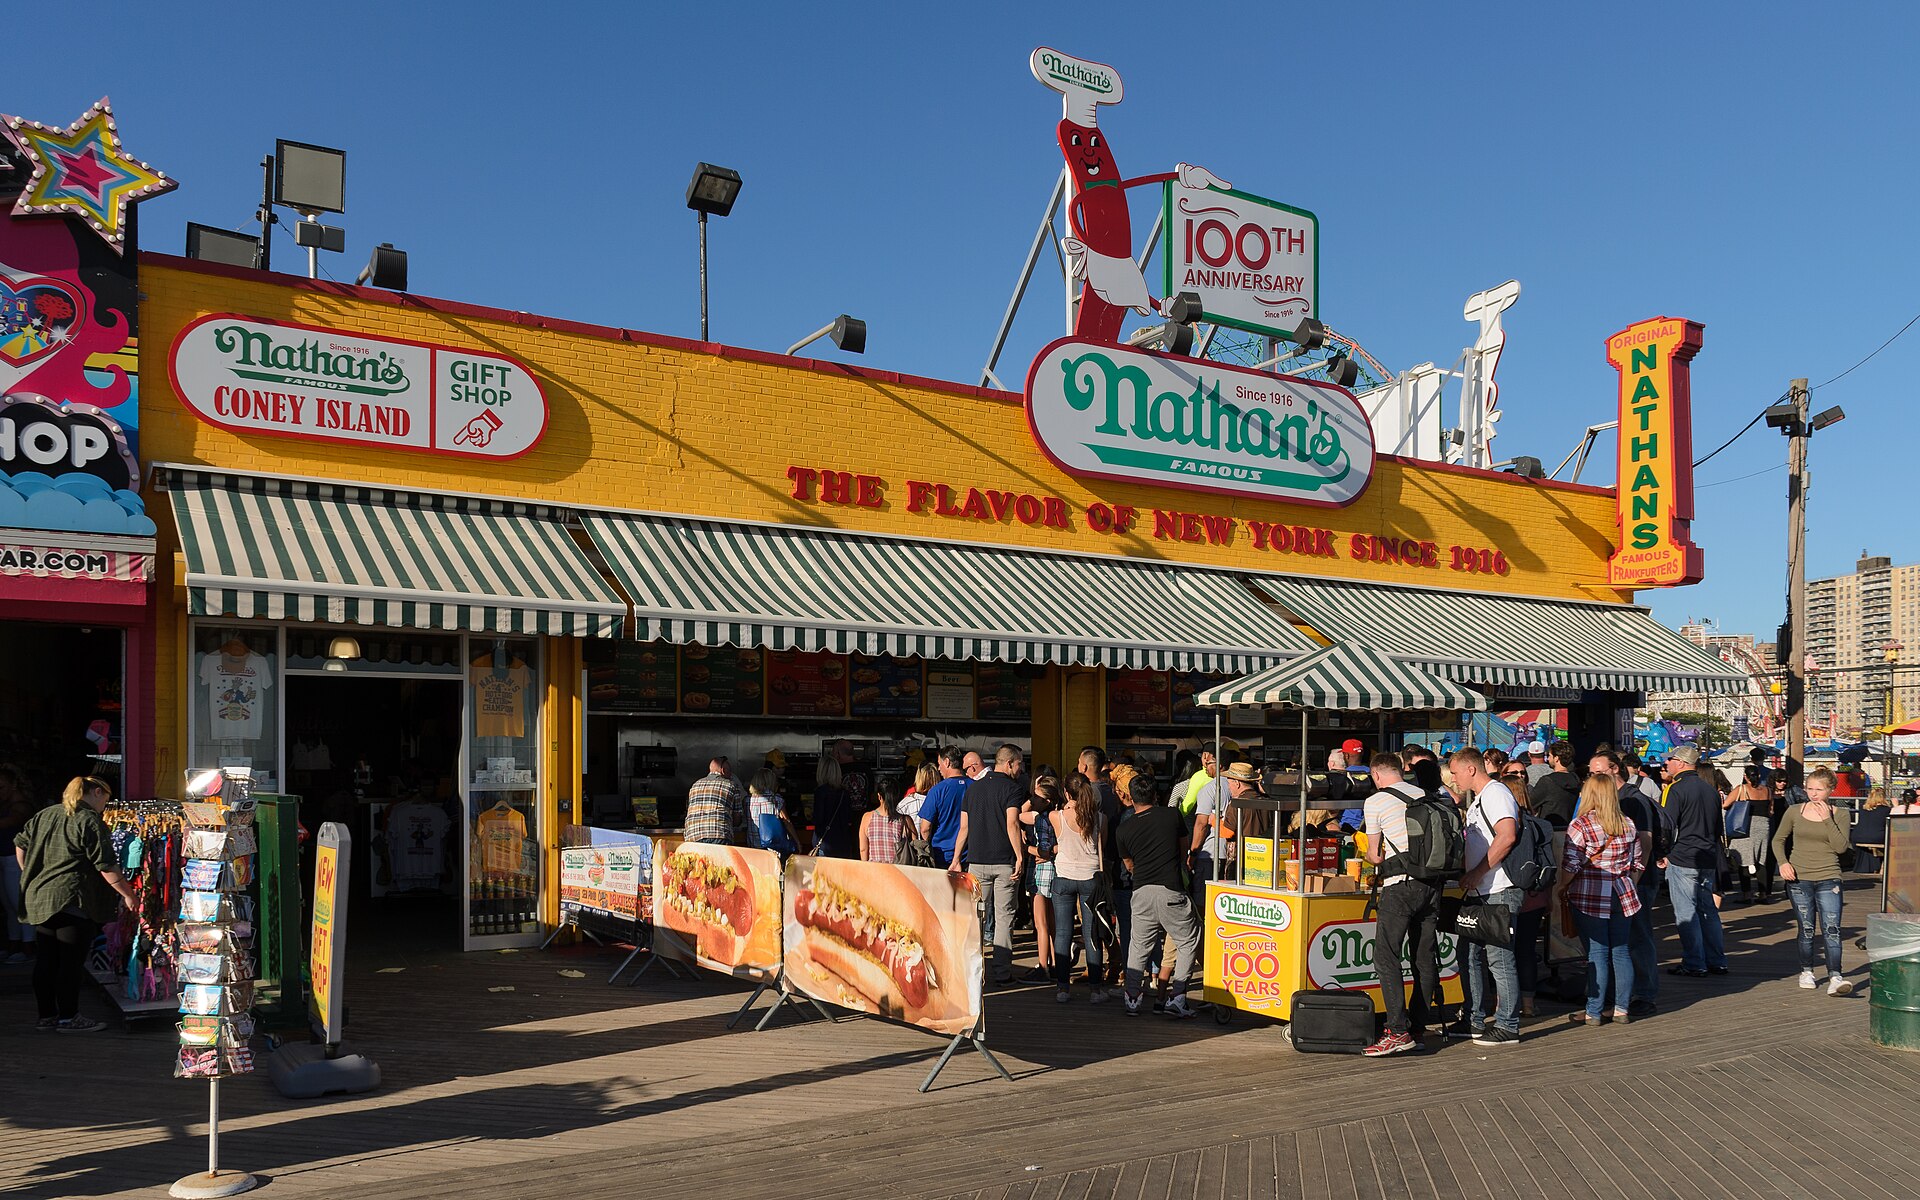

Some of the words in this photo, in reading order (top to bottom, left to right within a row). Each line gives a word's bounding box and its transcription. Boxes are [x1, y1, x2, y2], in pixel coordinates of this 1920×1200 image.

[1042, 54, 1111, 88] Nathan's
[1184, 218, 1305, 270] 100TH
[1184, 268, 1305, 293] ANNIVERSARY
[1264, 310, 1280, 319] Since
[1280, 308, 1294, 318] 1916
[329, 343, 351, 353] Since
[352, 346, 370, 355] 1916
[1613, 324, 1677, 349] ORIGINAL
[213, 325, 404, 385] Nathan's
[284, 377, 348, 391] FAMOUS
[450, 360, 512, 388] GIFT
[450, 383, 512, 407] SHOP
[1235, 385, 1266, 403] Since
[1269, 391, 1293, 407] 1916
[213, 385, 306, 425] CONEY
[315, 397, 411, 437] ISLAND
[1060, 352, 1343, 467] Nathan's
[1630, 343, 1660, 550] NATHANS
[1169, 459, 1263, 482] FAMOUS
[786, 465, 882, 508] THE
[905, 479, 1069, 529] FLAVOR
[1085, 502, 1134, 534] OF
[1152, 509, 1233, 545] NEW
[1249, 520, 1337, 557] YORK
[1349, 533, 1437, 567] SINCE
[1449, 545, 1508, 575] 1916
[0, 550, 107, 573] AR.COM
[1613, 558, 1679, 580] FRANKFURTERS
[1621, 550, 1670, 564] FAMOUS
[942, 675, 960, 683] Beer
[317, 856, 334, 894] NEW
[1220, 895, 1283, 921] Nathan's
[314, 925, 328, 961] GIFT
[1223, 941, 1245, 951] FOR
[1248, 941, 1278, 951] OVER
[311, 957, 328, 996] SHOP
[1223, 952, 1280, 979] 100
[1222, 979, 1280, 996] YEARS
